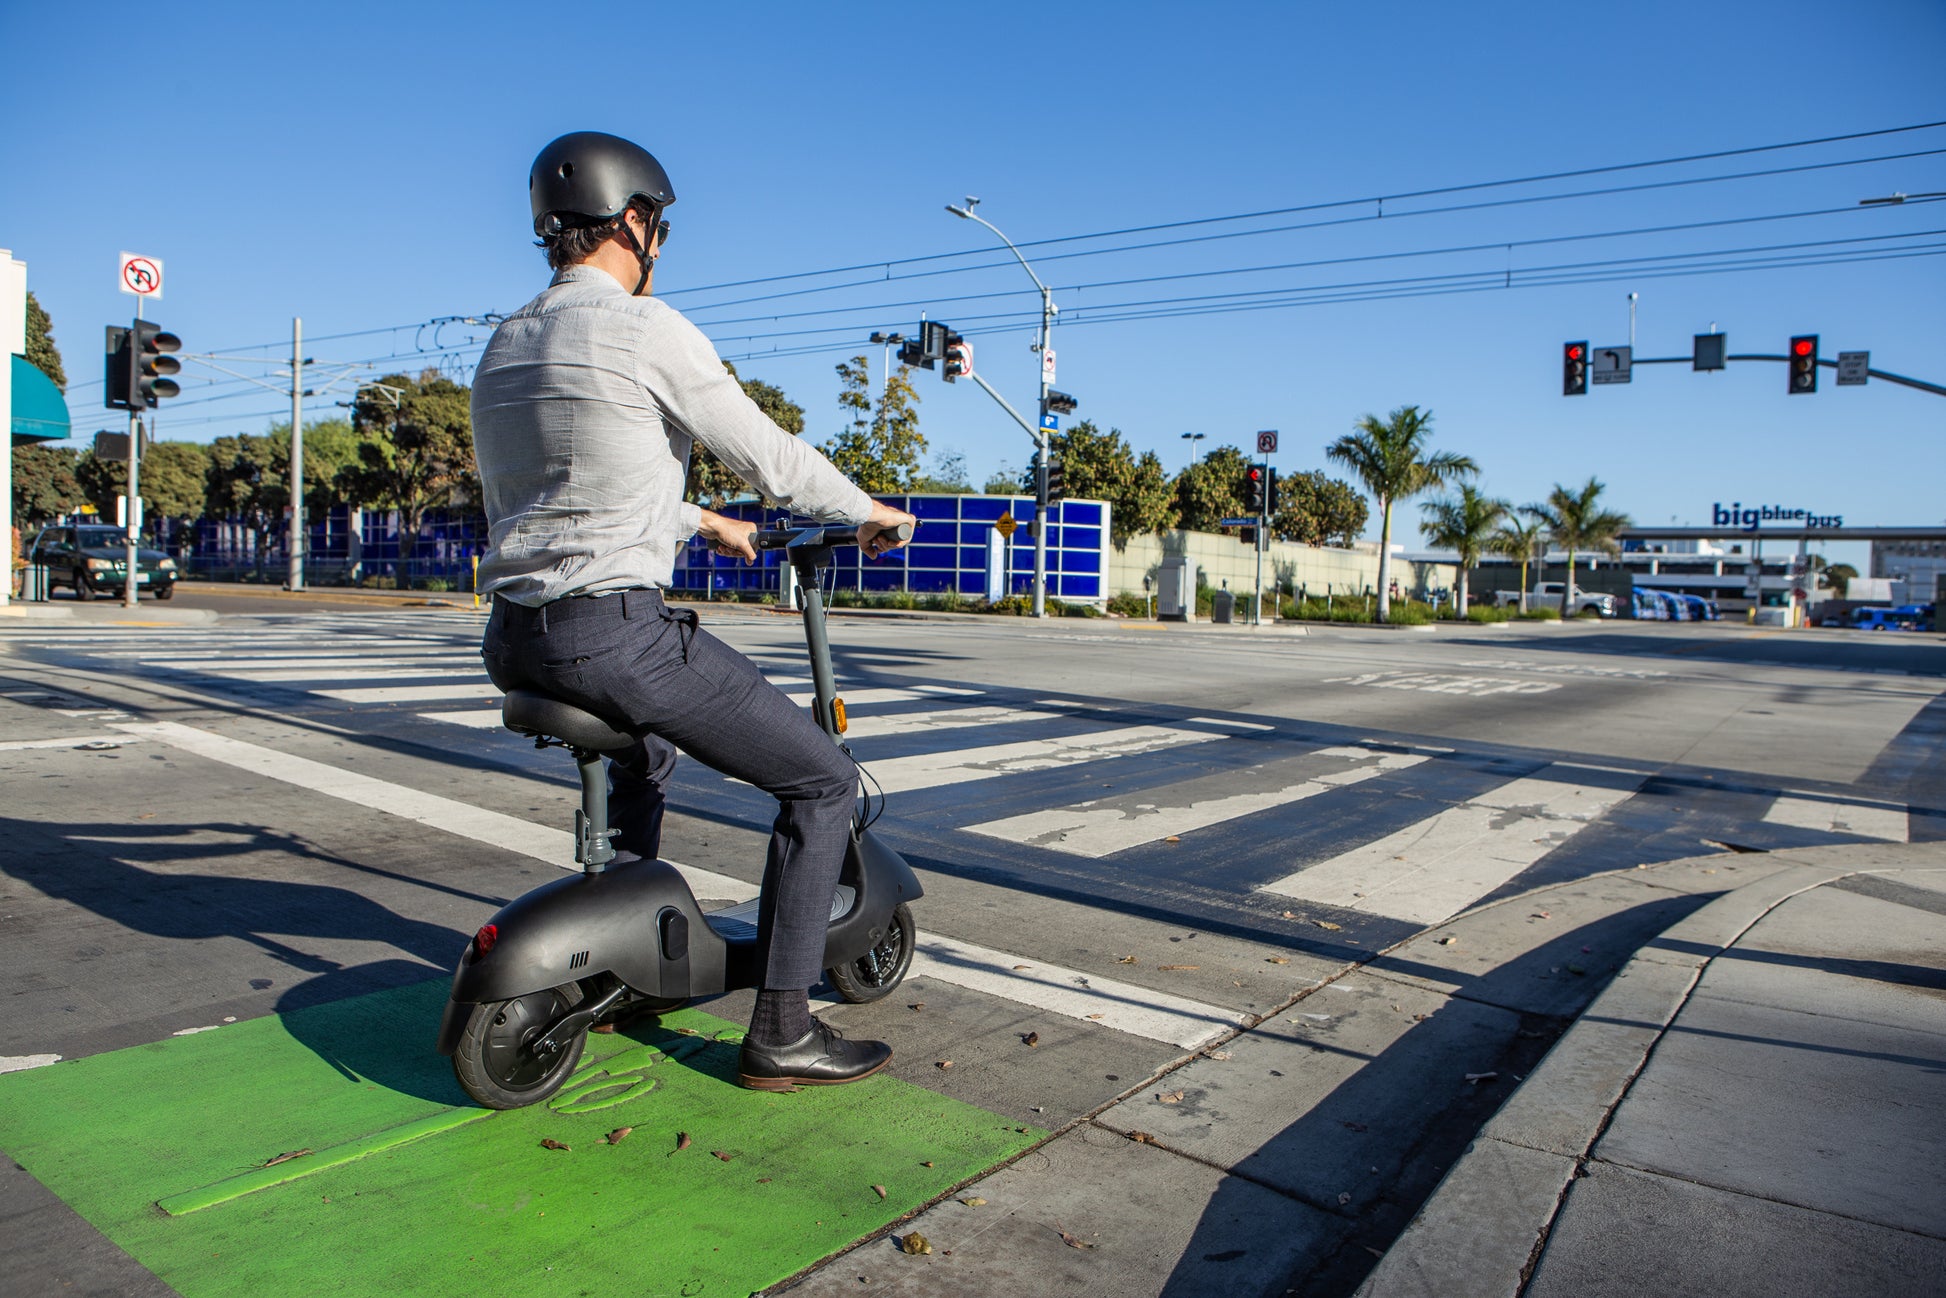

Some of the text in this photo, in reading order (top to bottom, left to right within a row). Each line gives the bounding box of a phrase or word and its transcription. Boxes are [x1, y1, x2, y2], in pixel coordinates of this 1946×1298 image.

[1712, 502, 1843, 531] big blue bus
[1321, 670, 1564, 697] KEEP
